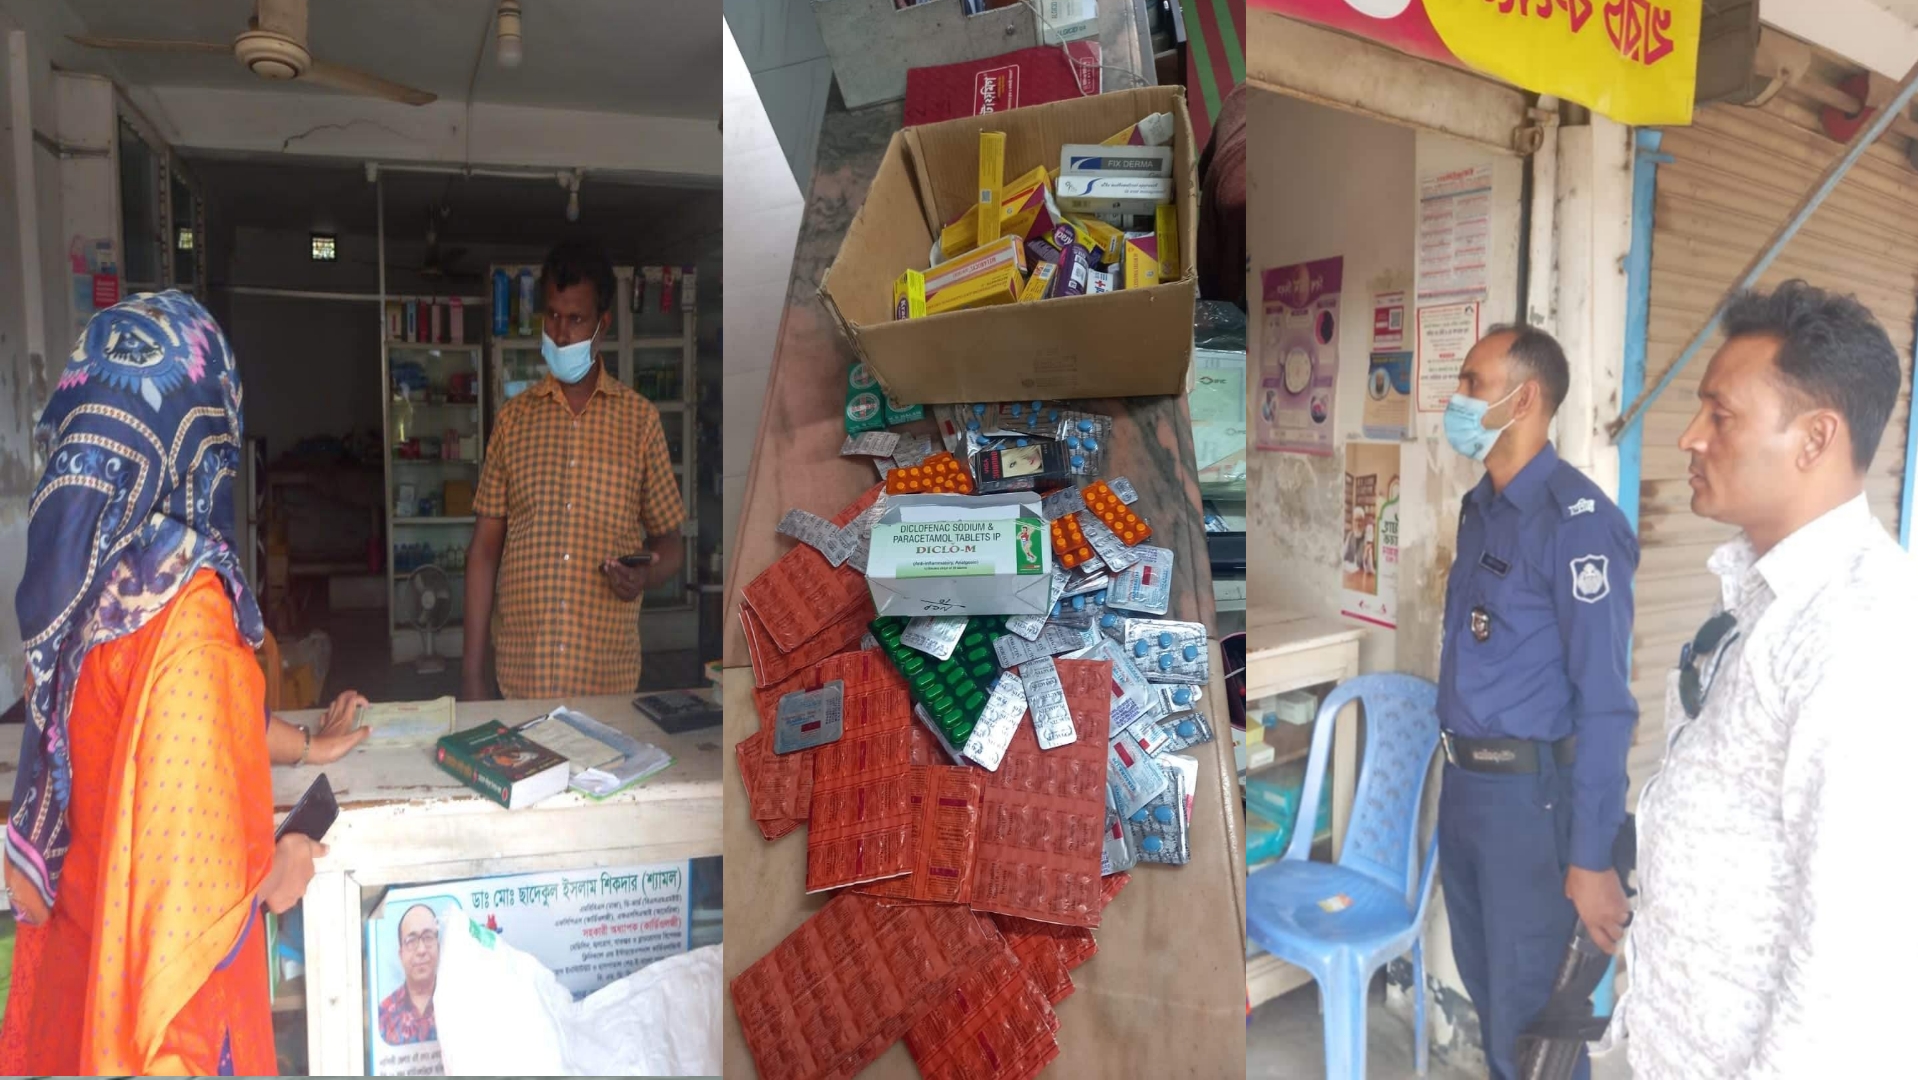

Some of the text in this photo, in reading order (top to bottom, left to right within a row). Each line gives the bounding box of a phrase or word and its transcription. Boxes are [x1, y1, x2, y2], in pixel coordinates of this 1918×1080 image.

[1107, 159, 1153, 168] FIX DERMA
[900, 522, 994, 533] DICLOFENAC SODIUM &
[893, 532, 1001, 544] PARACETAMOL TABLETS IP
[915, 545, 976, 554] DICLO-M
[471, 866, 682, 909] ডাঃ মোঃ ছাদেকুল ইসলাম শিকদার (শ্যামল)
[582, 921, 608, 938] সহকারী
